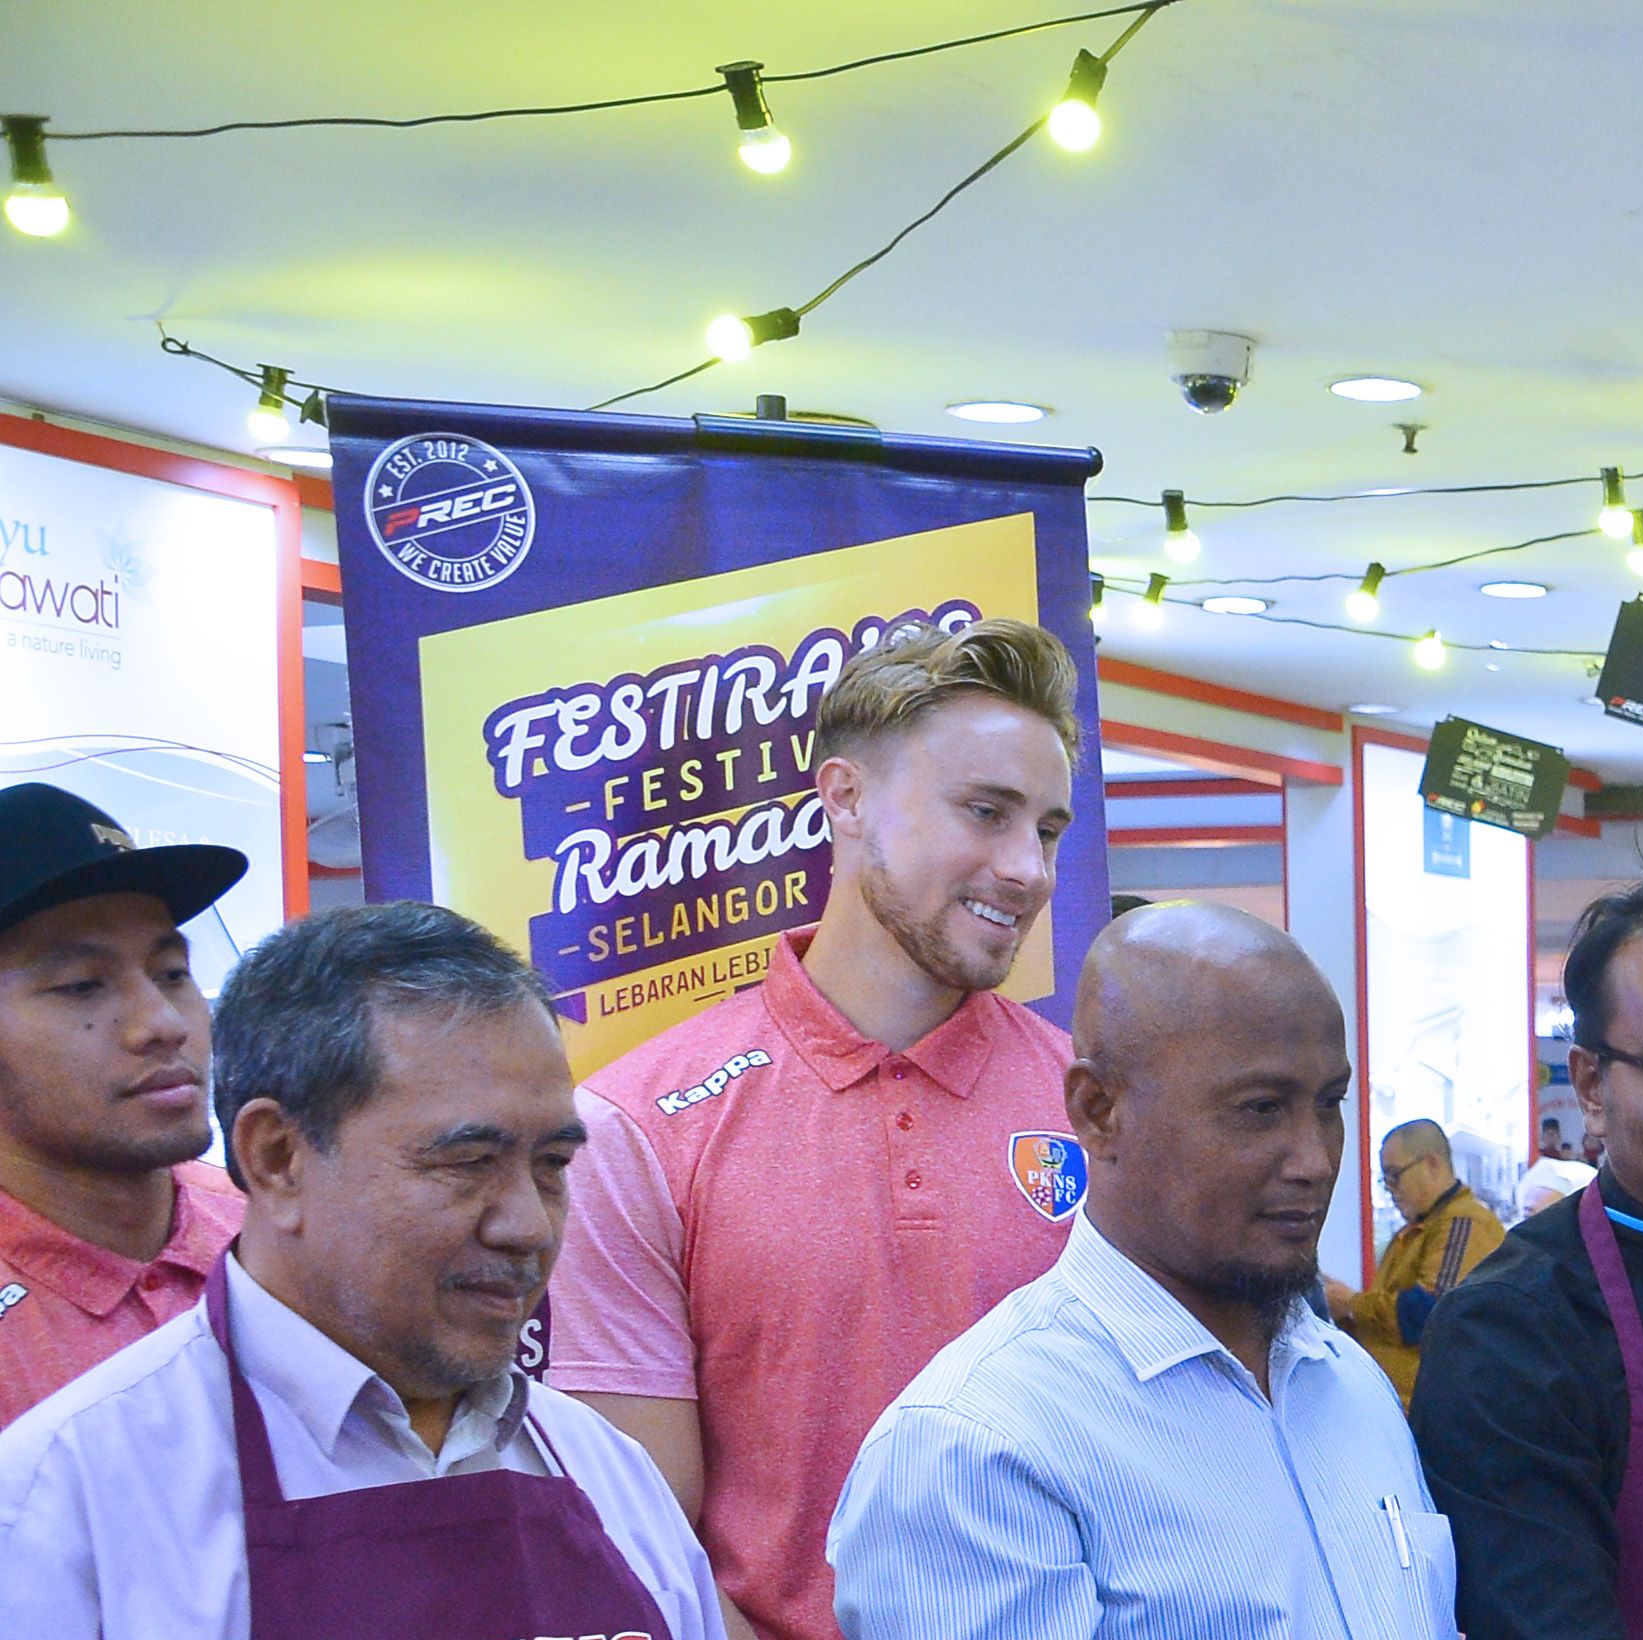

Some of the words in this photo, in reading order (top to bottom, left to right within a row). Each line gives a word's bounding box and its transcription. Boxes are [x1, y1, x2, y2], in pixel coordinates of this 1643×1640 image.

[386, 448, 423, 480] EST.
[424, 440, 469, 462] 2012
[384, 484, 517, 537] PREC
[398, 542, 428, 571] WE
[427, 555, 496, 583] CREATE
[489, 513, 526, 565] VALUE
[22, 634, 75, 656] nature
[80, 639, 121, 670] living
[493, 609, 973, 788] FESTIRA'
[587, 870, 809, 963] SELANGOR
[600, 967, 707, 1018] LEBARAN
[656, 1049, 773, 1116] Kappa
[1027, 1170, 1077, 1191] PKNS
[1054, 1189, 1076, 1204] FC
